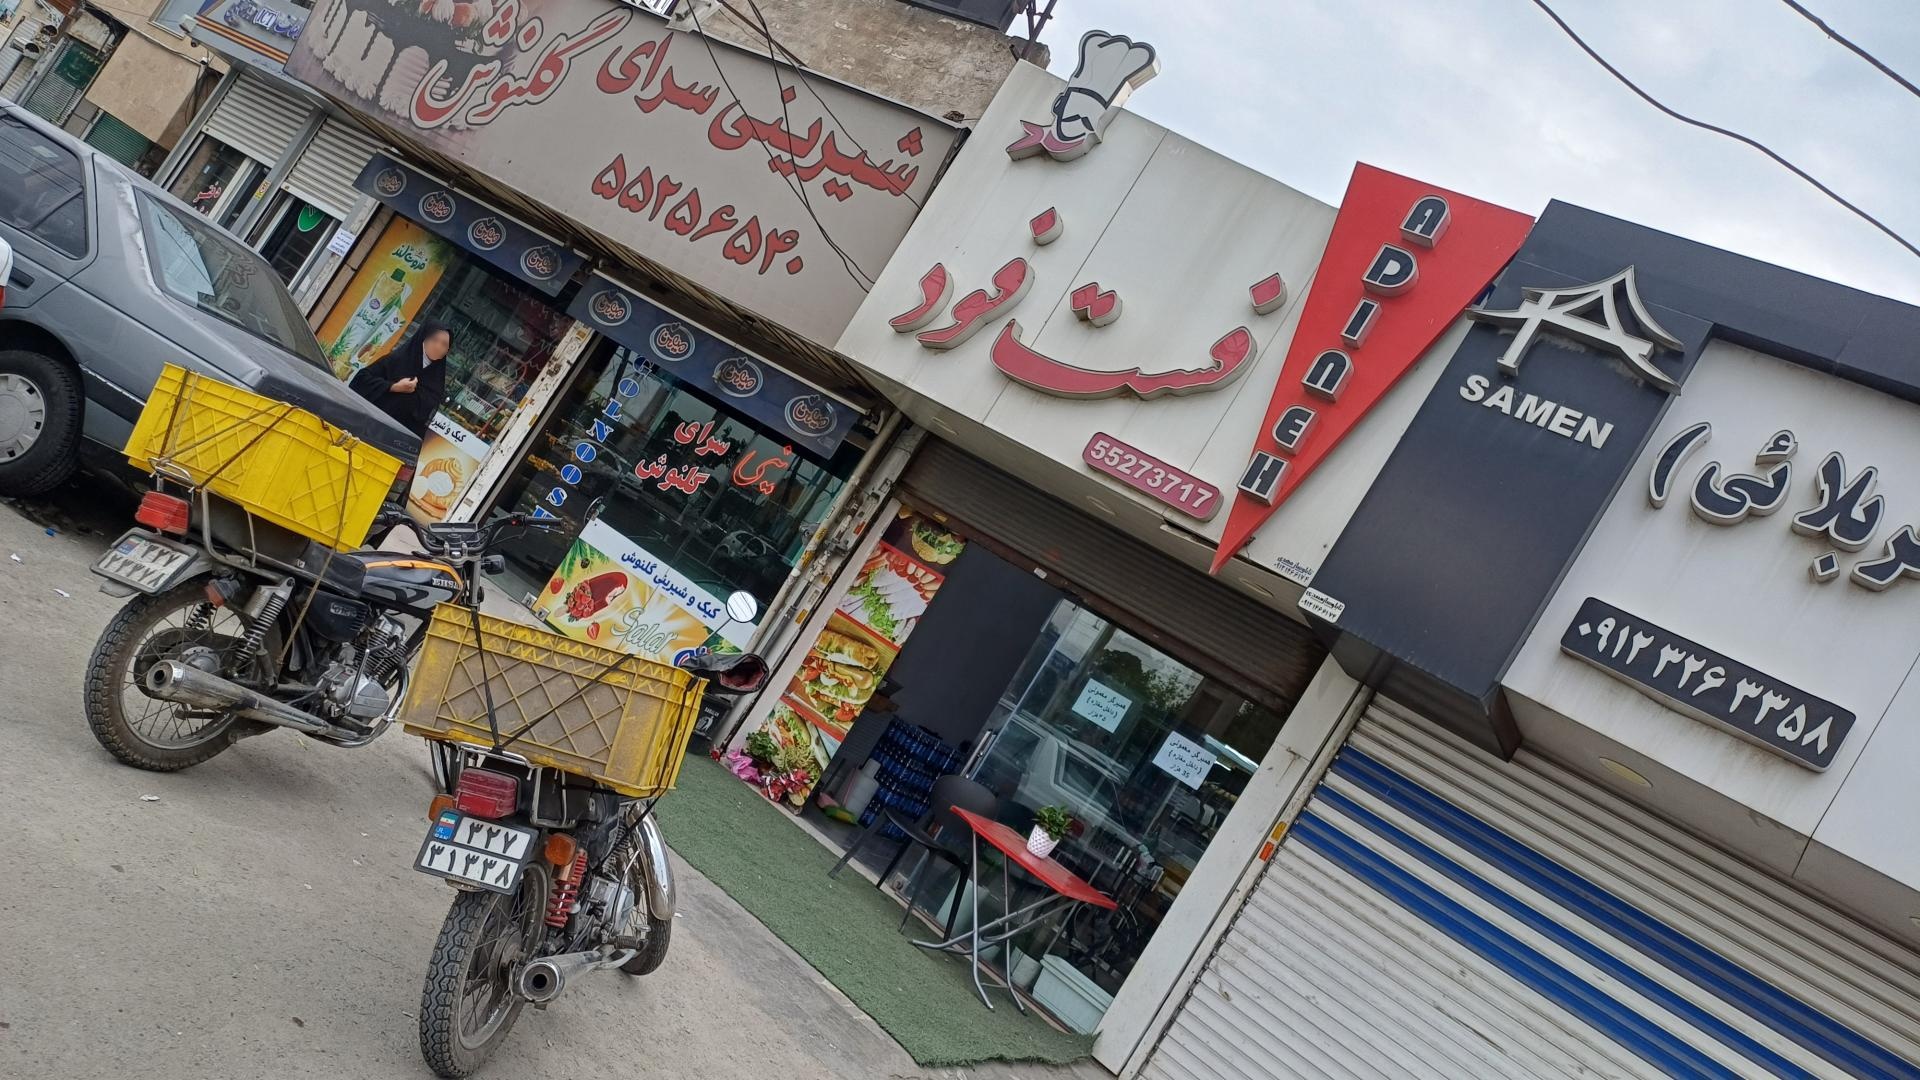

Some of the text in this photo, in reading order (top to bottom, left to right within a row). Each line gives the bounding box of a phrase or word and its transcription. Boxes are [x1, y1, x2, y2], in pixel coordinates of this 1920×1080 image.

[597, 33, 720, 114] سرای
[708, 86, 922, 201] شیرینی
[591, 153, 804, 275] ۵۵۲۵۶۵۴۰
[1237, 194, 1452, 506] ADINEH
[431, 419, 446, 431] شیر
[674, 420, 730, 456] سرای
[1459, 374, 1615, 450] SAMEN
[635, 453, 711, 494] گلنوش
[1090, 439, 1213, 510] 55273717
[621, 552, 721, 619] کیک و شیرینی گلنوش
[1578, 617, 1655, 665] ۰۹۱۲
[1729, 677, 1834, 755] ۳۳۵۸
[428, 843, 511, 887] ۳۱۳۳۸
[467, 822, 518, 854] ۳۲۷
